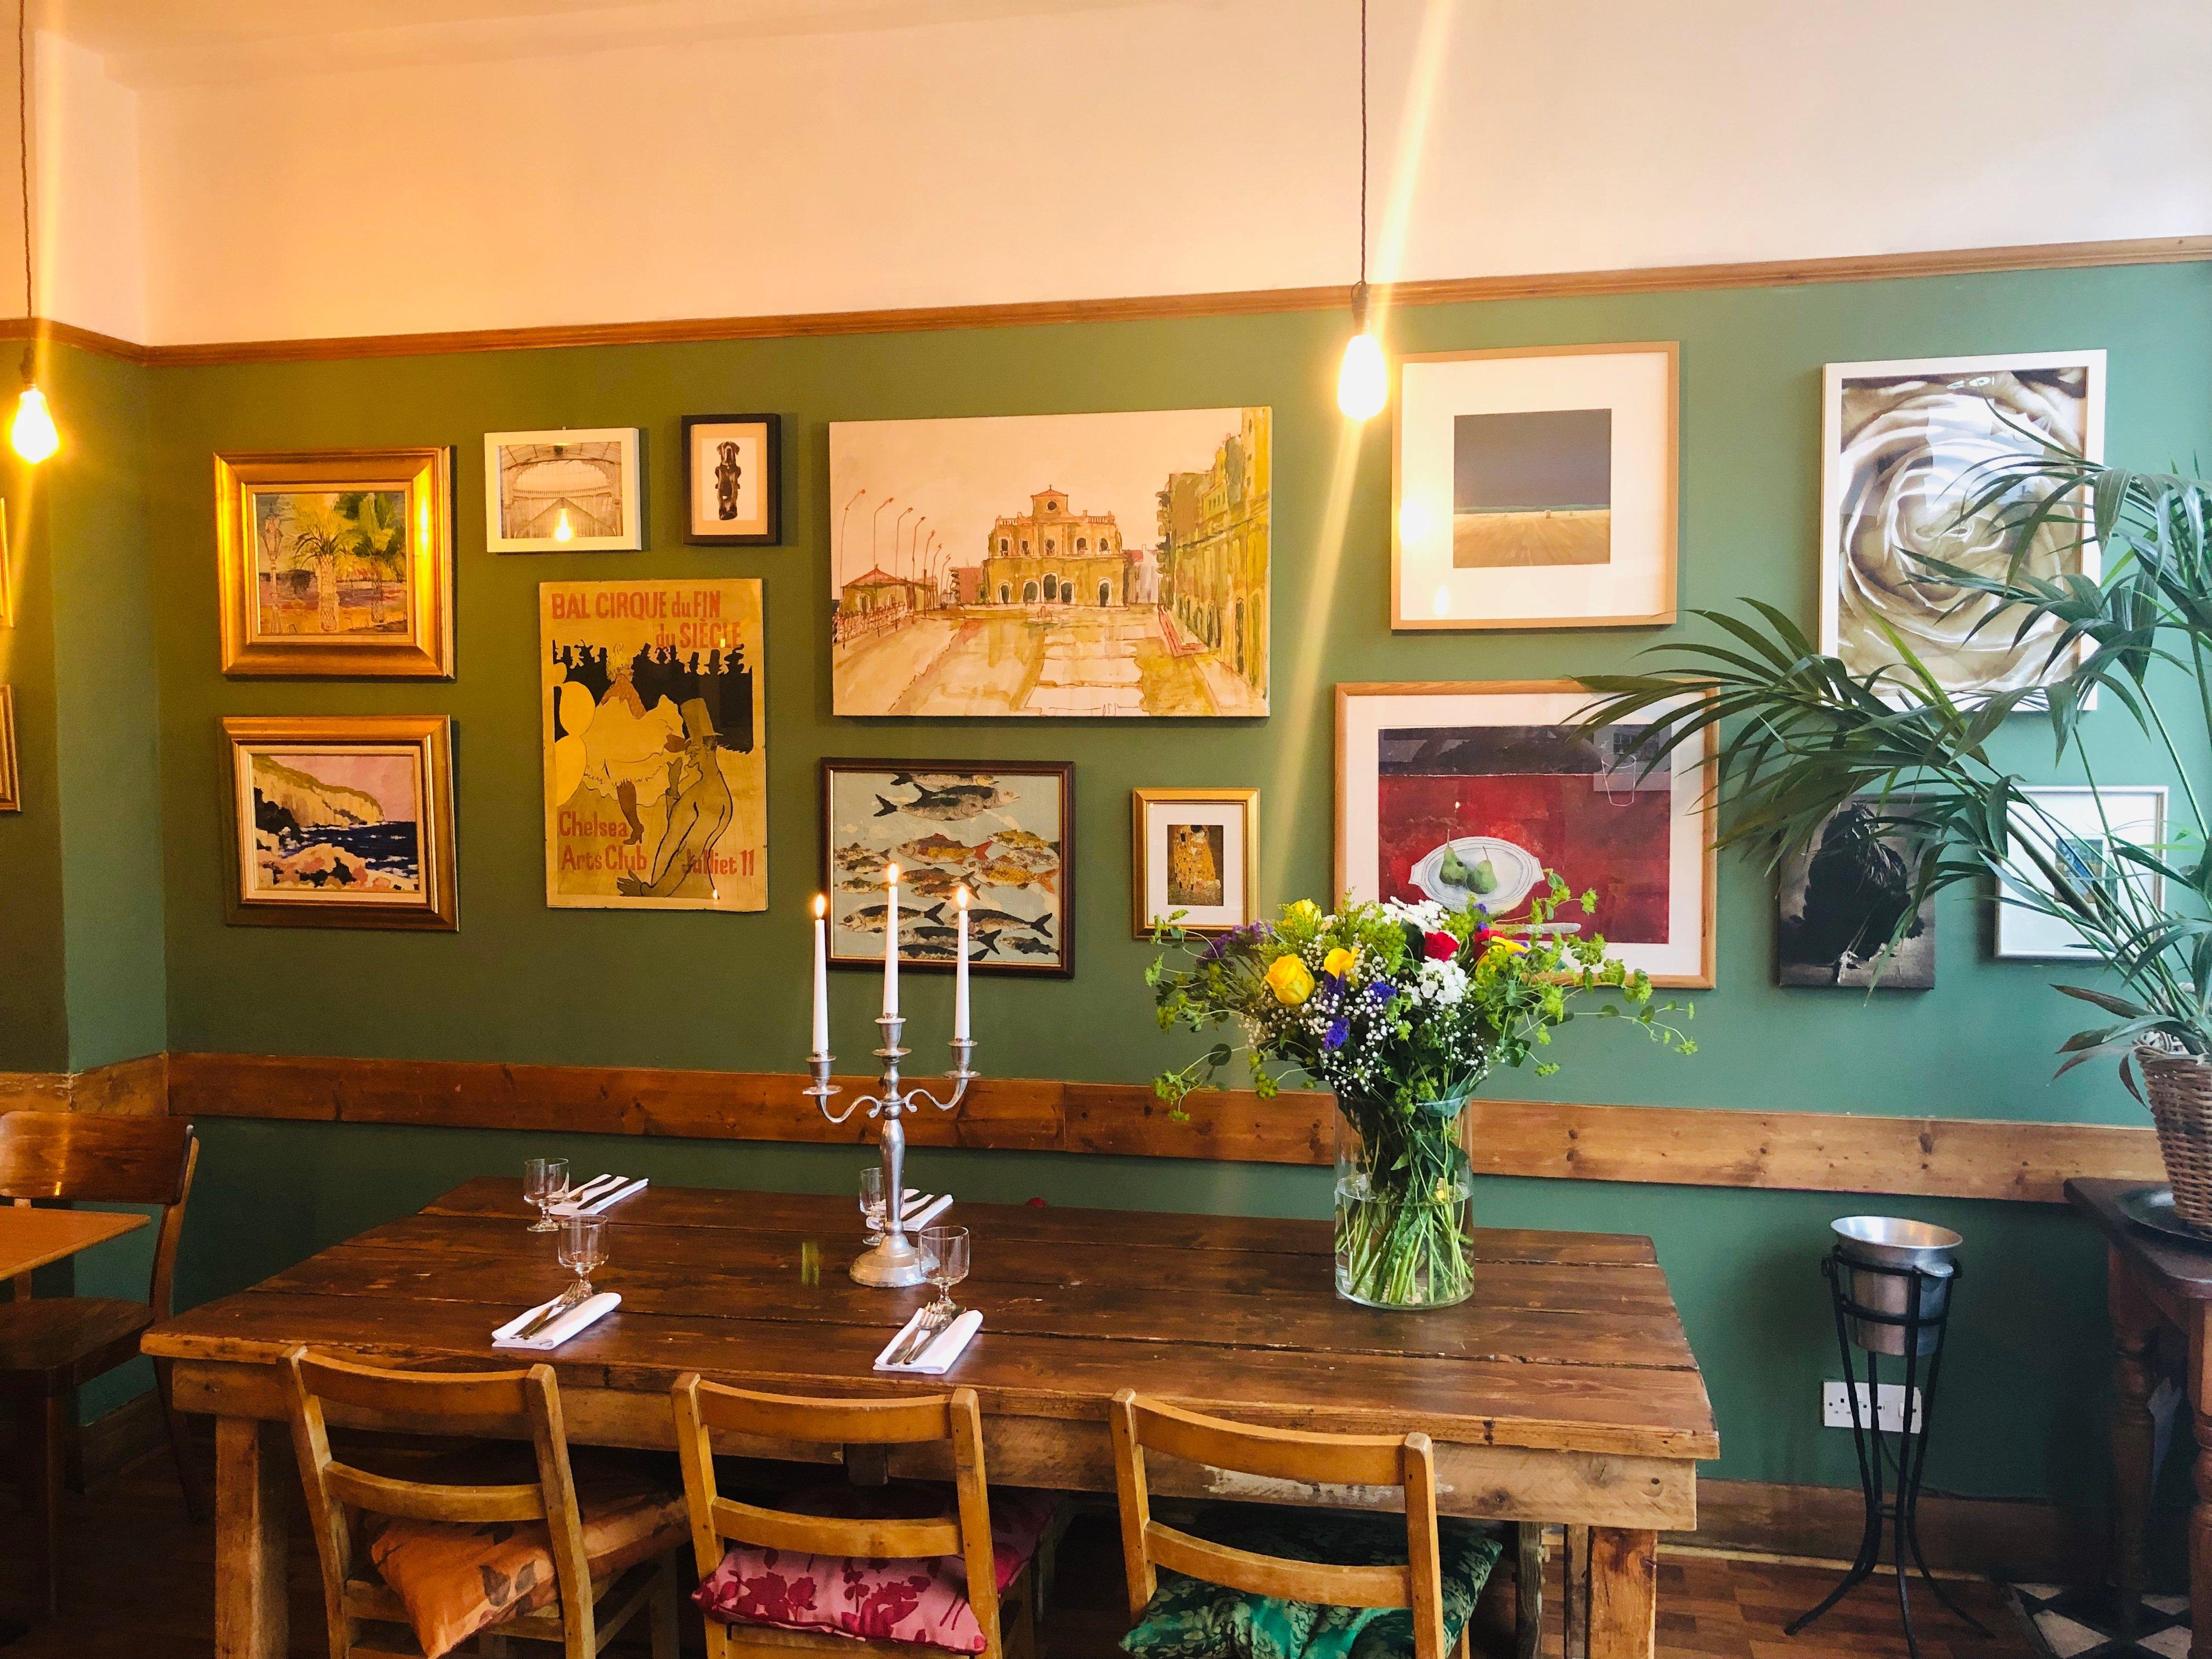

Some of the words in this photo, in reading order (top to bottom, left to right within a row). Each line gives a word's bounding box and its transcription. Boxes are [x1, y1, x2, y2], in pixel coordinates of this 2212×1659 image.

[551, 592, 590, 619] BAL
[595, 591, 667, 620] CIRQUE
[672, 591, 691, 618] du
[693, 590, 721, 618] FIN
[656, 623, 675, 647] du
[559, 810, 628, 837] Chelsea
[561, 844, 602, 871] Arts
[605, 844, 647, 871] Club
[740, 849, 754, 876] 11
